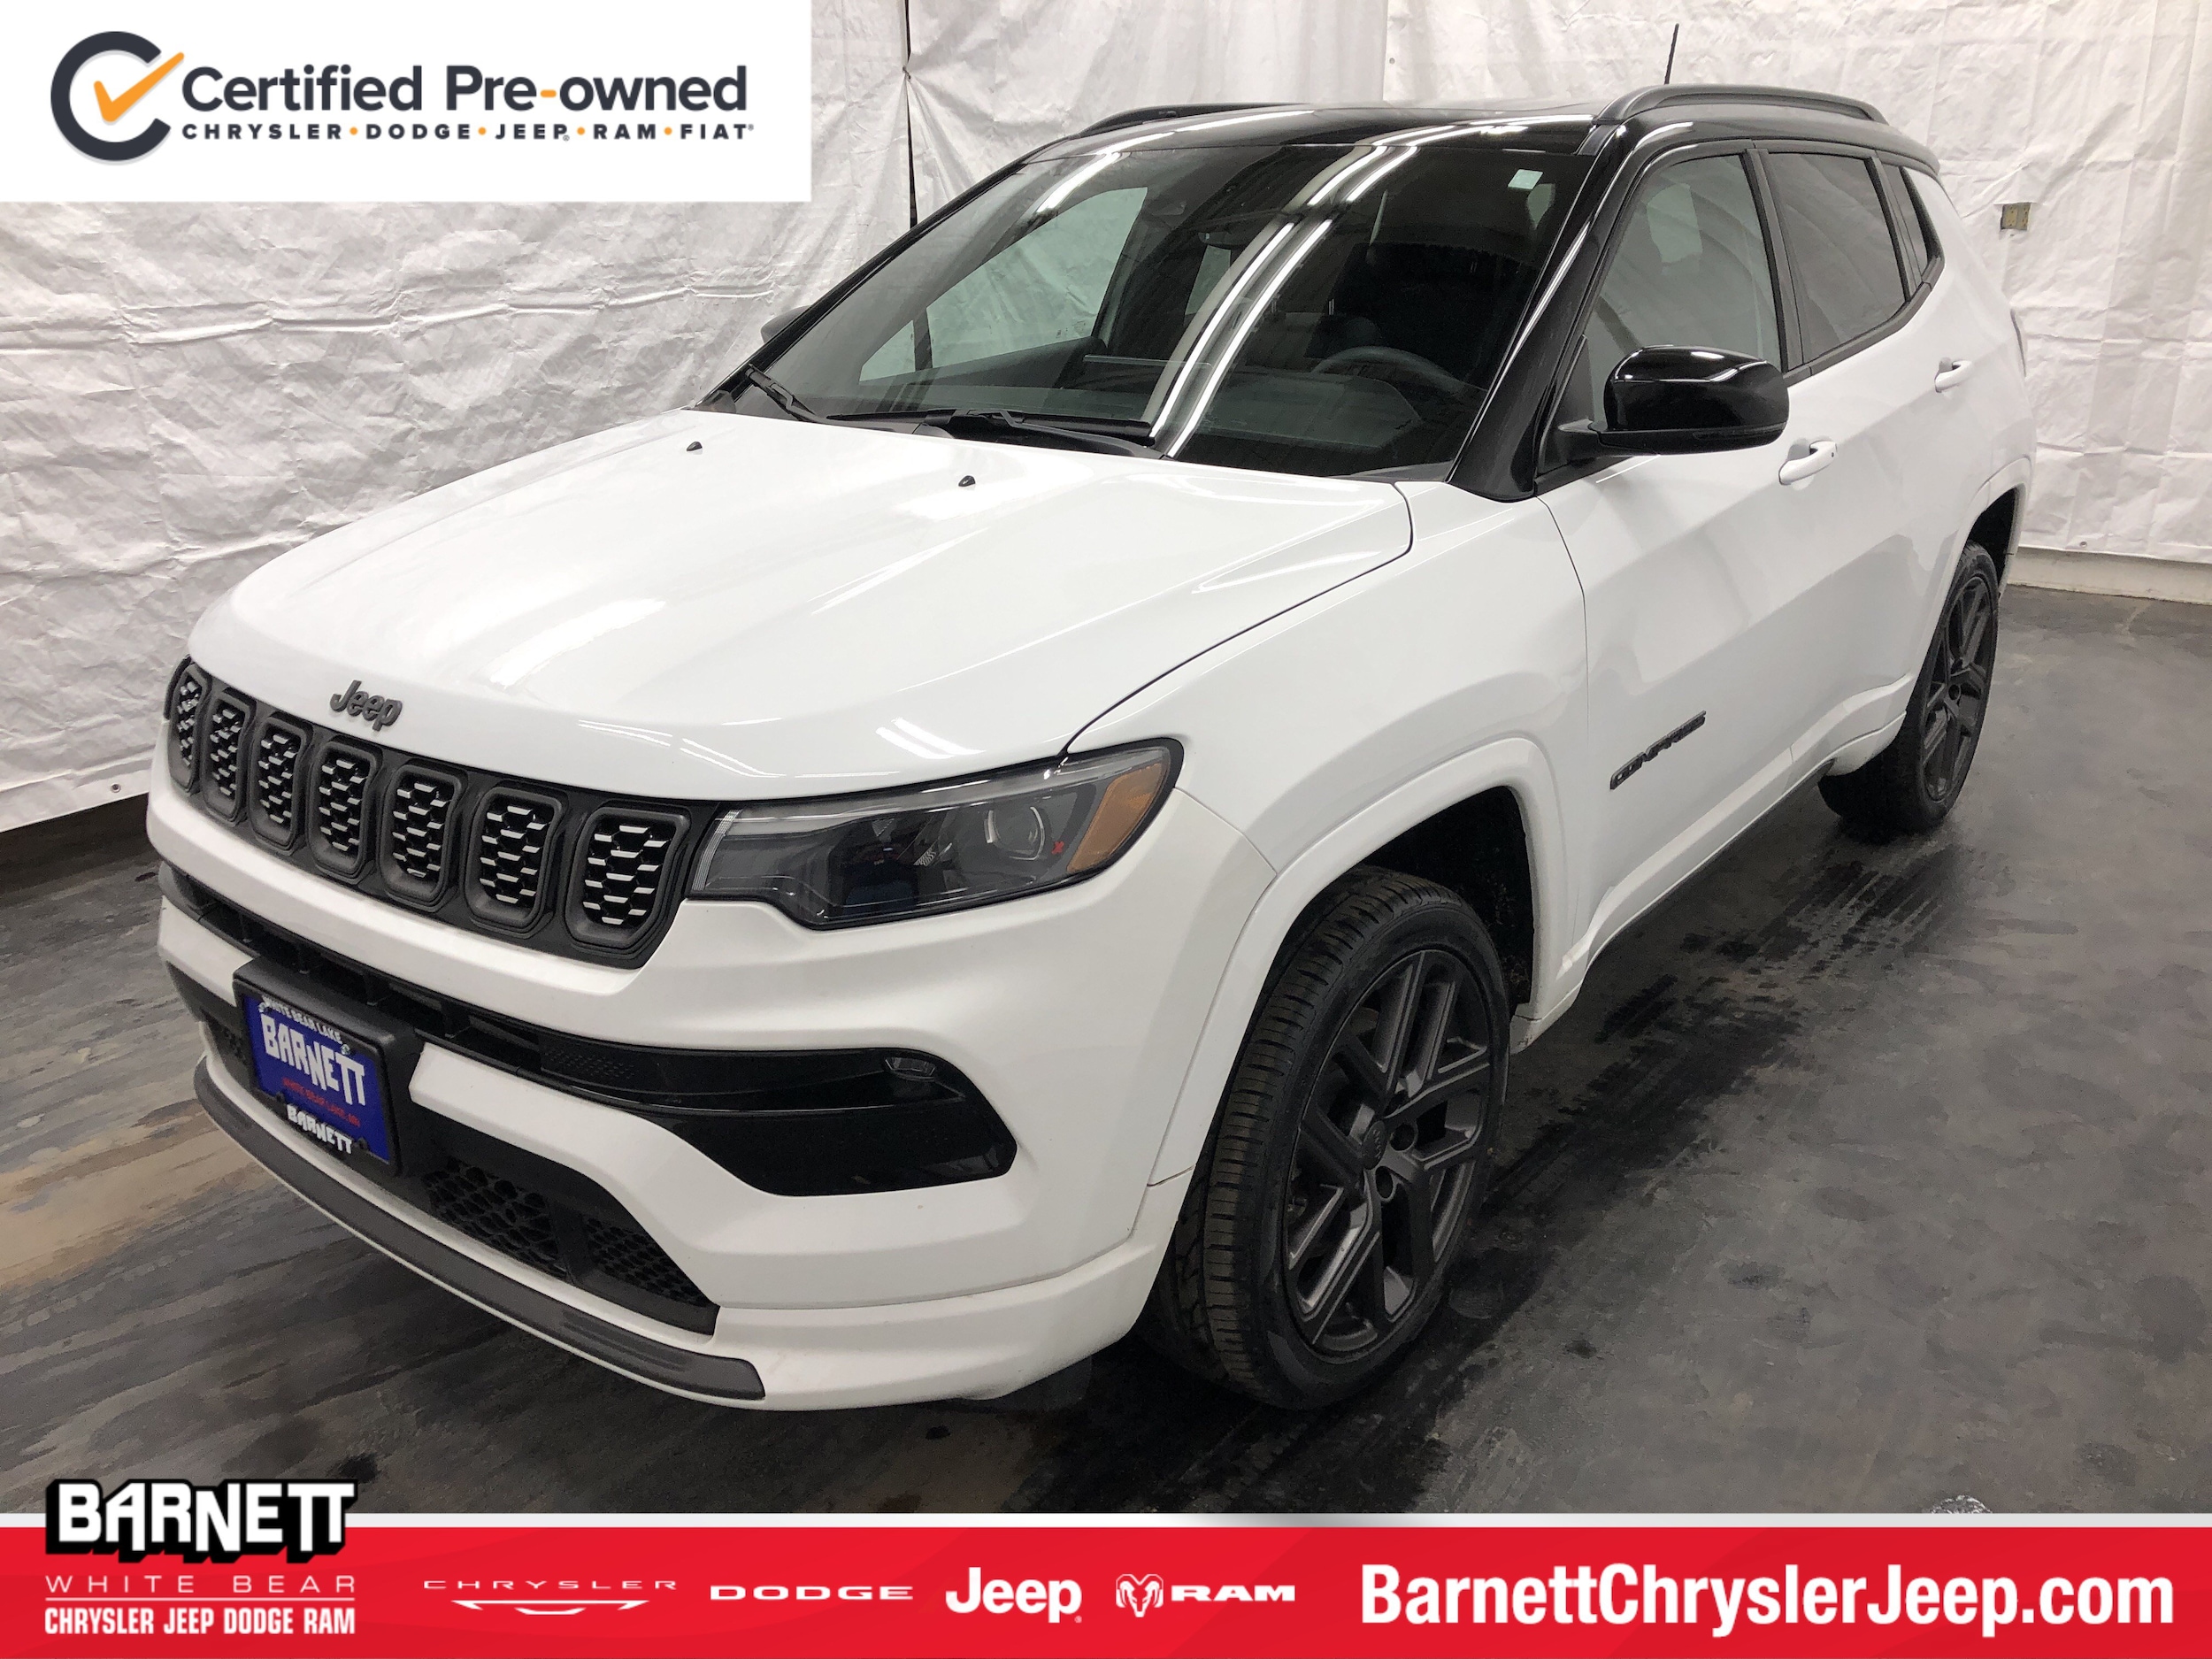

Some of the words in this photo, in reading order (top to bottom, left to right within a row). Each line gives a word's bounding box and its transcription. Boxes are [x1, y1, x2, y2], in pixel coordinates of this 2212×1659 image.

[330, 680, 403, 732] Jeep
[316, 1022, 343, 1045] LAKE
[260, 1013, 366, 1106] BARNETT
[287, 1104, 352, 1154] BARNETT
